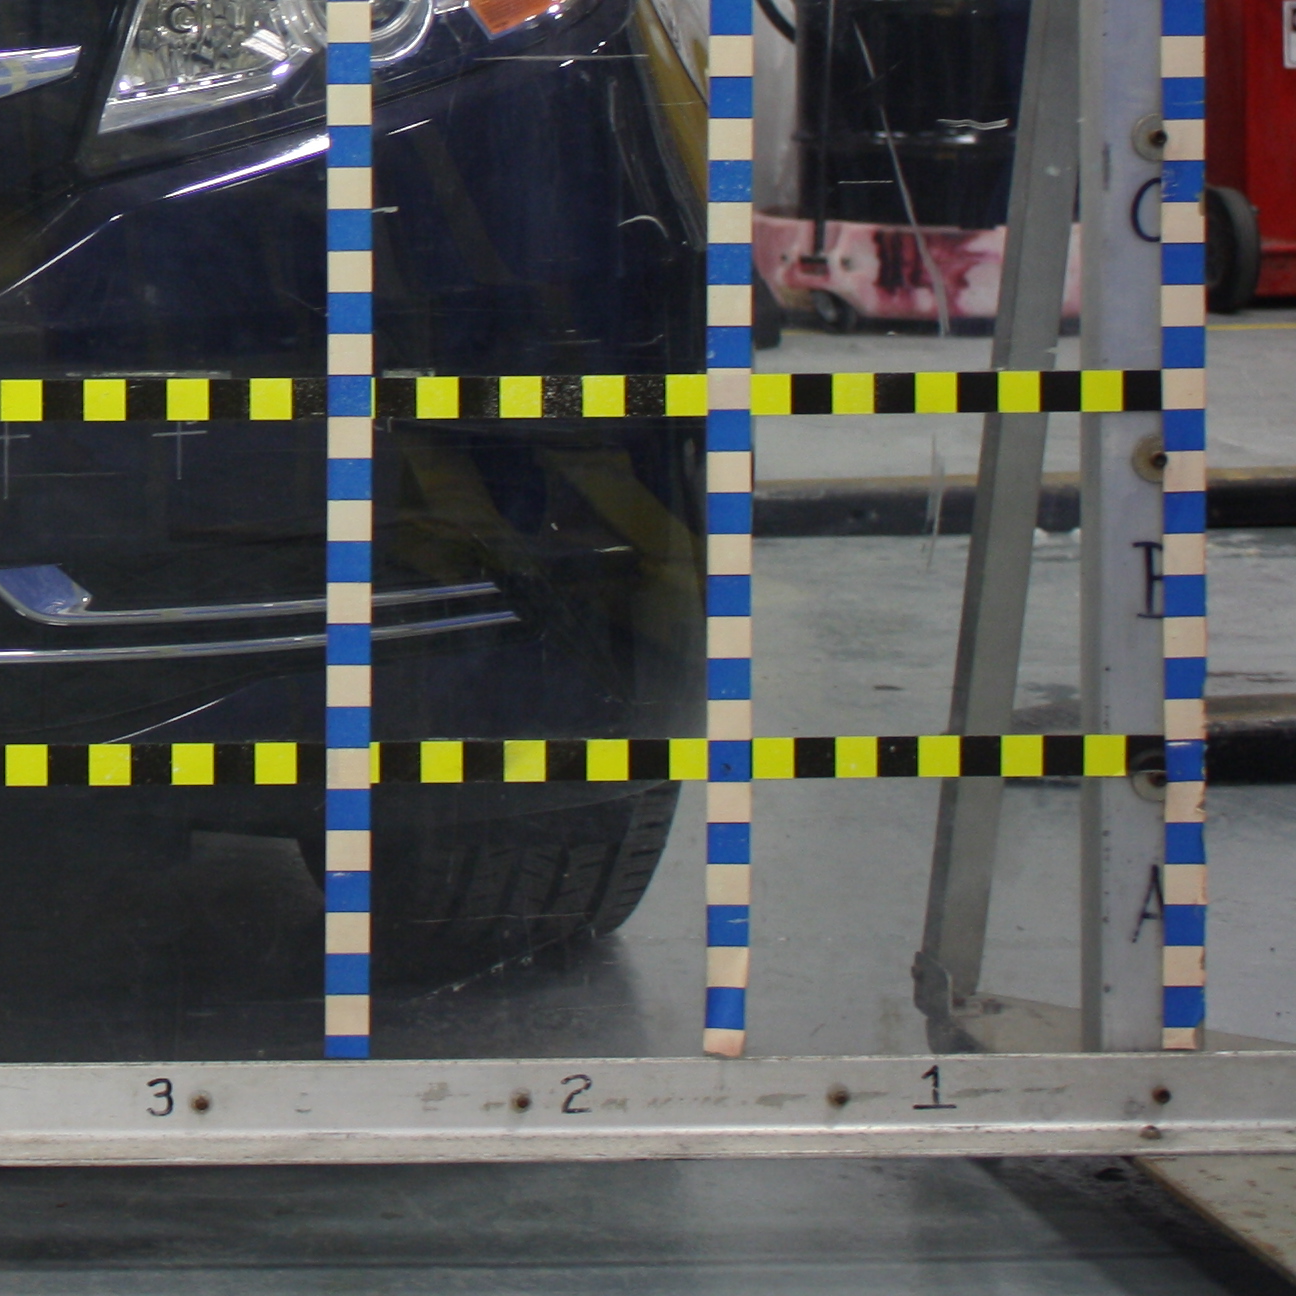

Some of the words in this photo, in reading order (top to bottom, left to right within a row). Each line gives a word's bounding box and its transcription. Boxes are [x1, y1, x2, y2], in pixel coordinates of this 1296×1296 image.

[146, 1077, 174, 1117] 3
[560, 1074, 593, 1115] 2
[913, 1065, 957, 1110] 1
